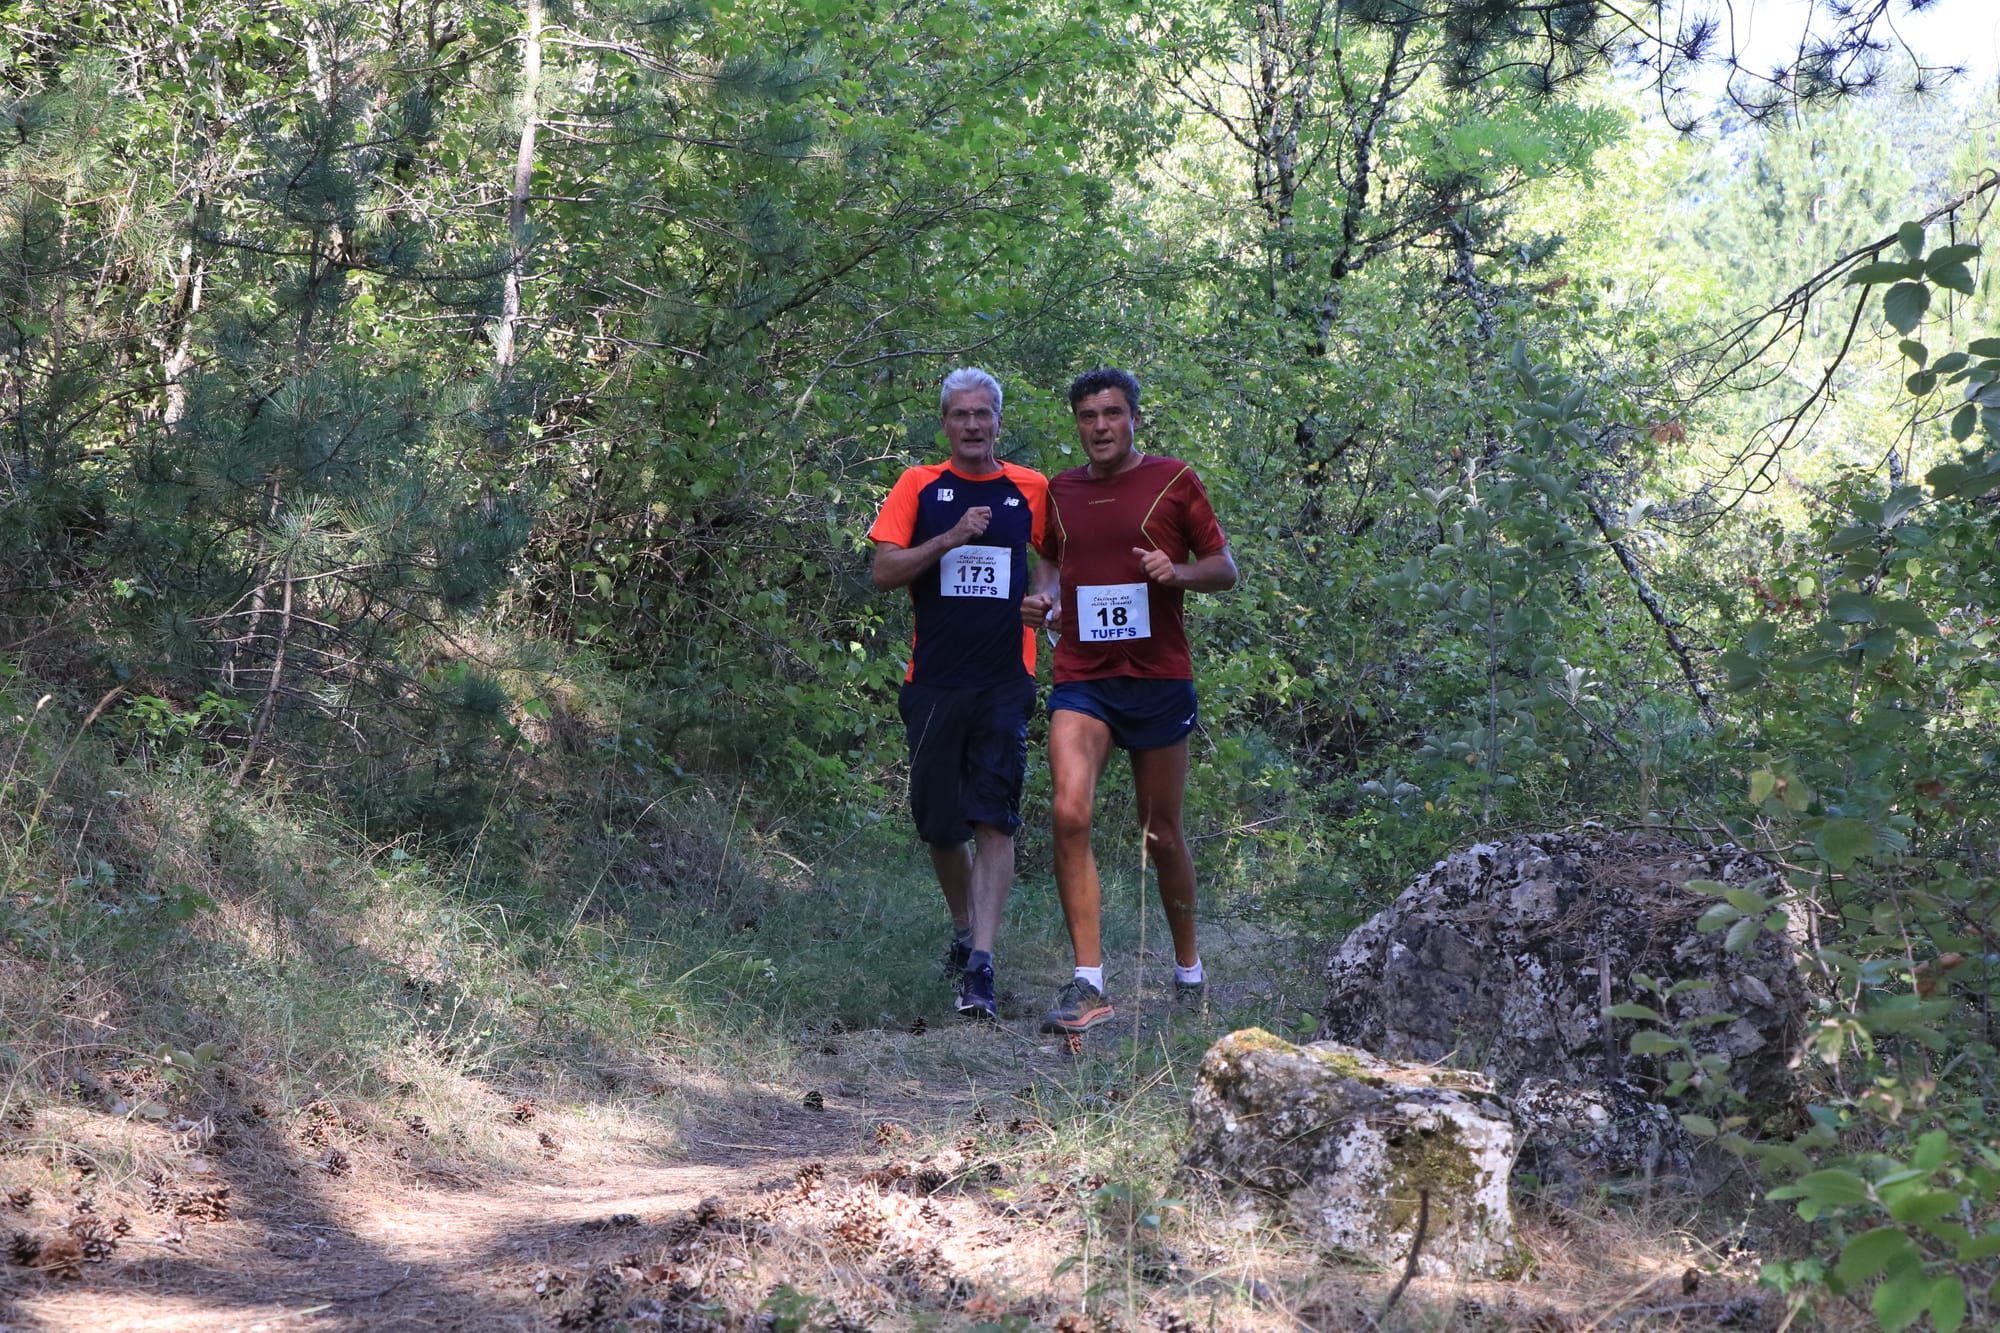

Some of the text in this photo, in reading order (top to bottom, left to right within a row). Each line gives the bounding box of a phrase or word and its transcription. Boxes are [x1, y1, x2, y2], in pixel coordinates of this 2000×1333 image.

[957, 565, 995, 584] 173
[953, 585, 998, 596] TUFF'S
[1097, 607, 1128, 627] 18
[1090, 627, 1137, 639] TUFF'S
